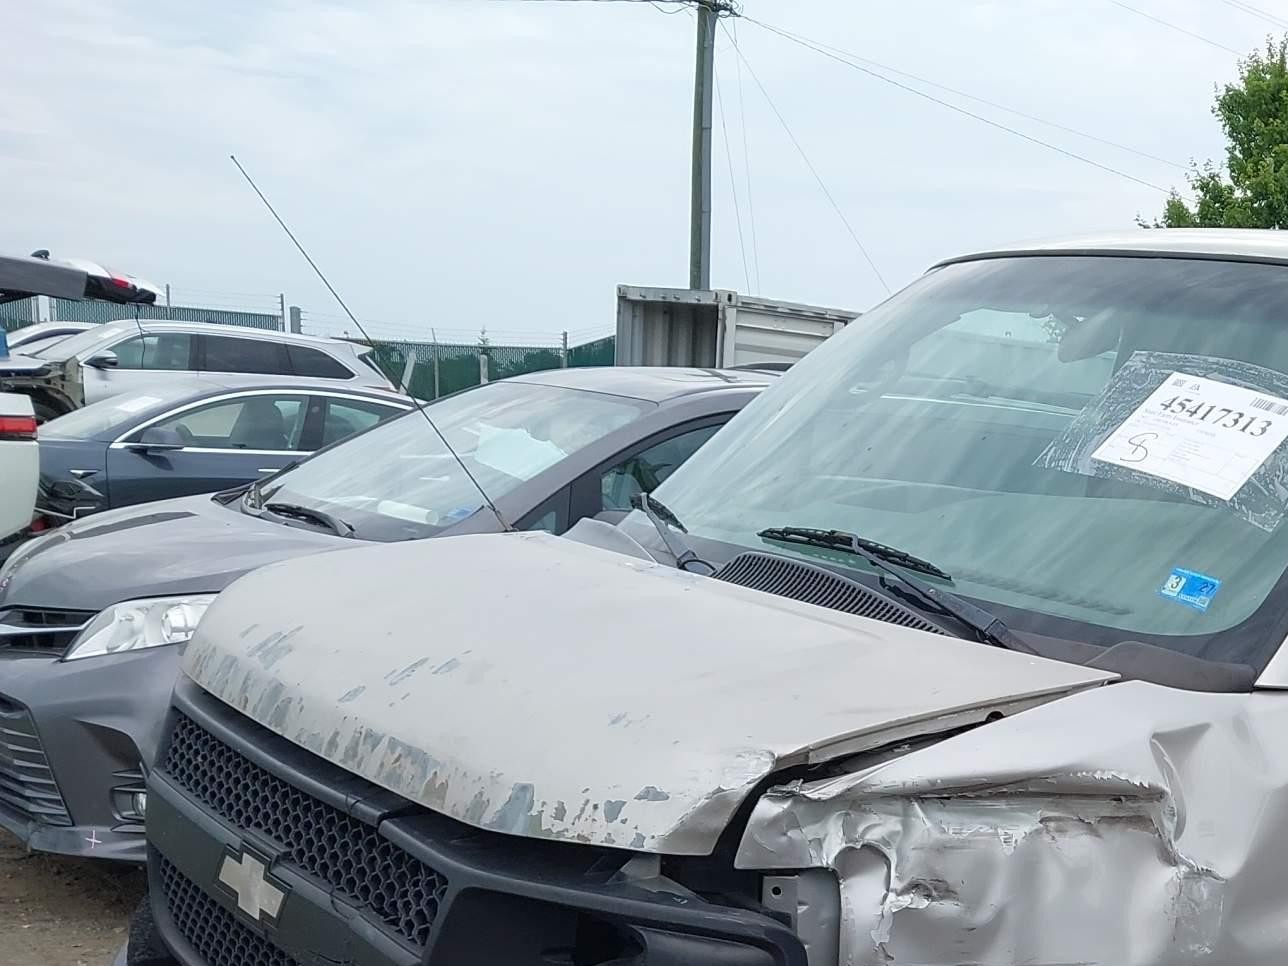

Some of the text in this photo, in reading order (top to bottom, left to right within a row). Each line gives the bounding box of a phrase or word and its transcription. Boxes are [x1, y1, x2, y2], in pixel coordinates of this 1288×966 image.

[1159, 395, 1273, 437] 45417313
[1170, 575, 1217, 594] 3 27
